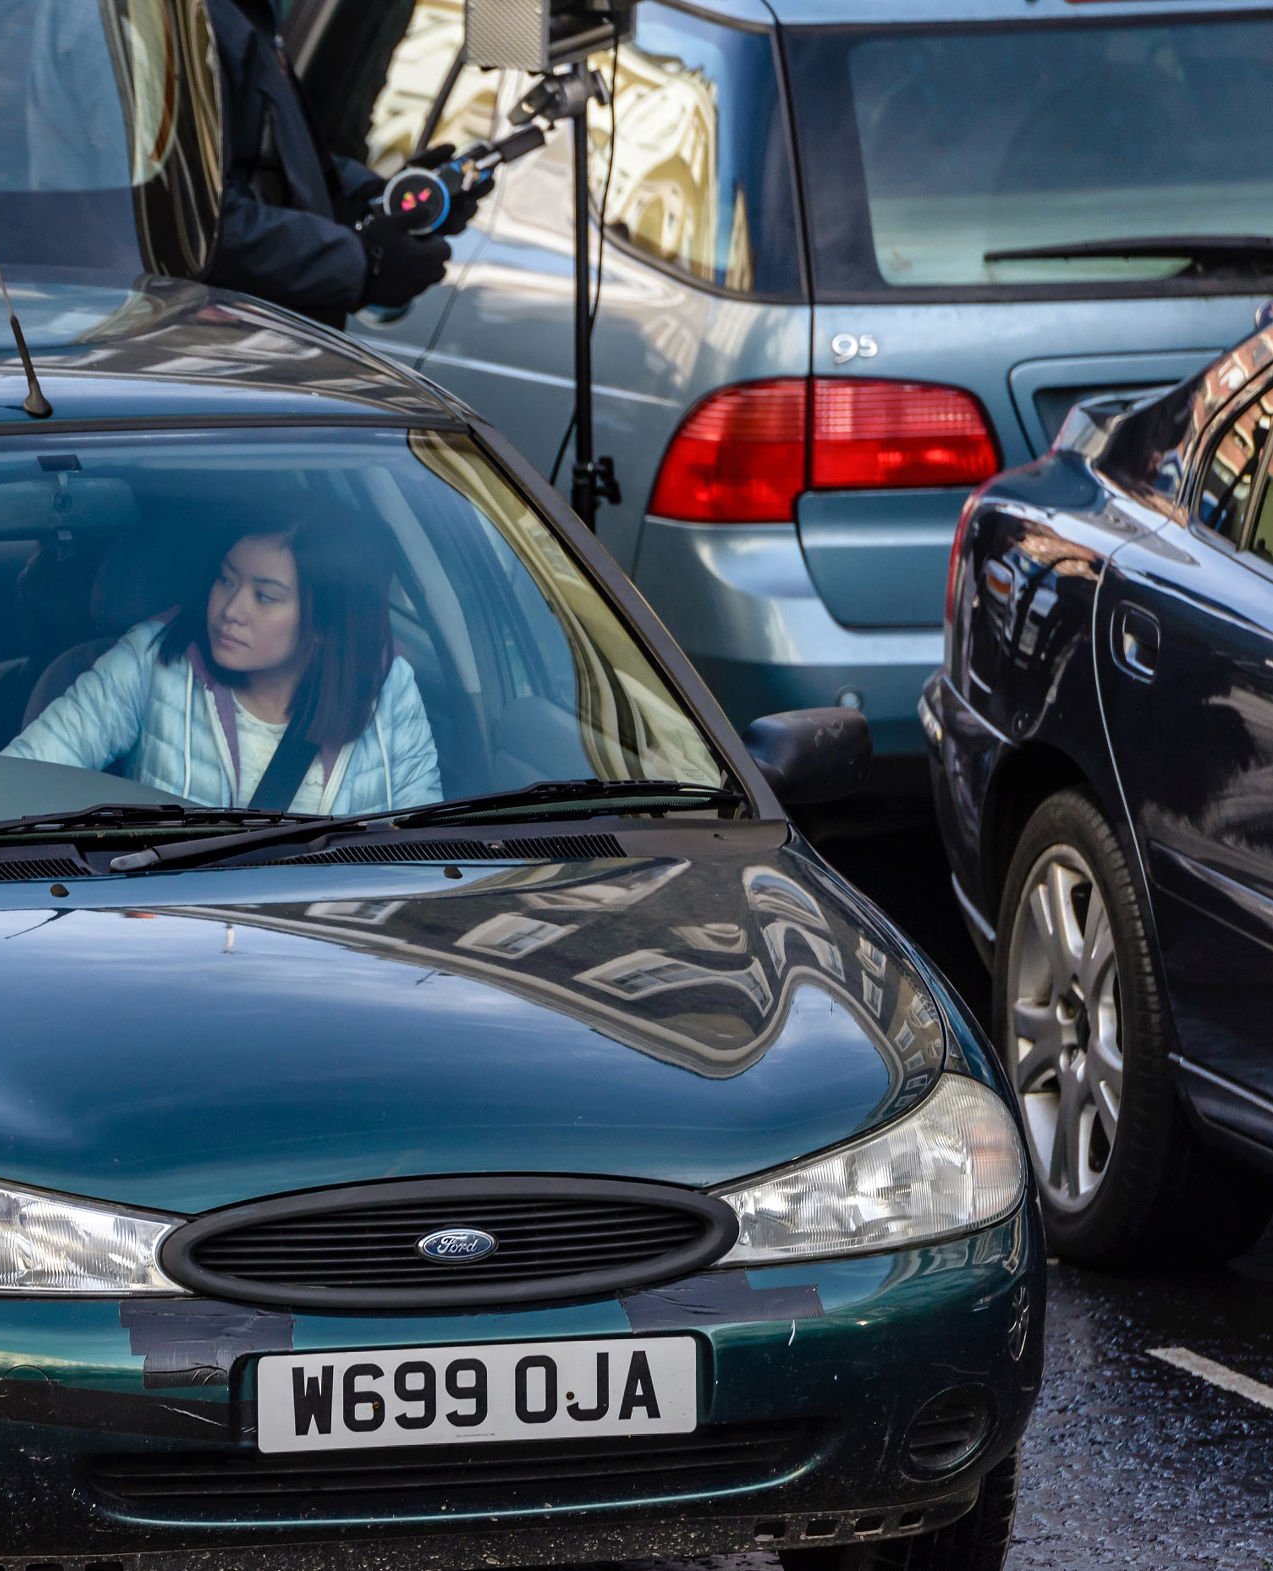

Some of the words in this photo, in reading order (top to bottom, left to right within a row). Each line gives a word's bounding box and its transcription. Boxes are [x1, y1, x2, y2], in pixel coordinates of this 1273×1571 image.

[830, 332, 879, 364] 95
[437, 1235, 480, 1254] Ford
[291, 1357, 489, 1437] W699
[514, 1350, 662, 1424] OJA
